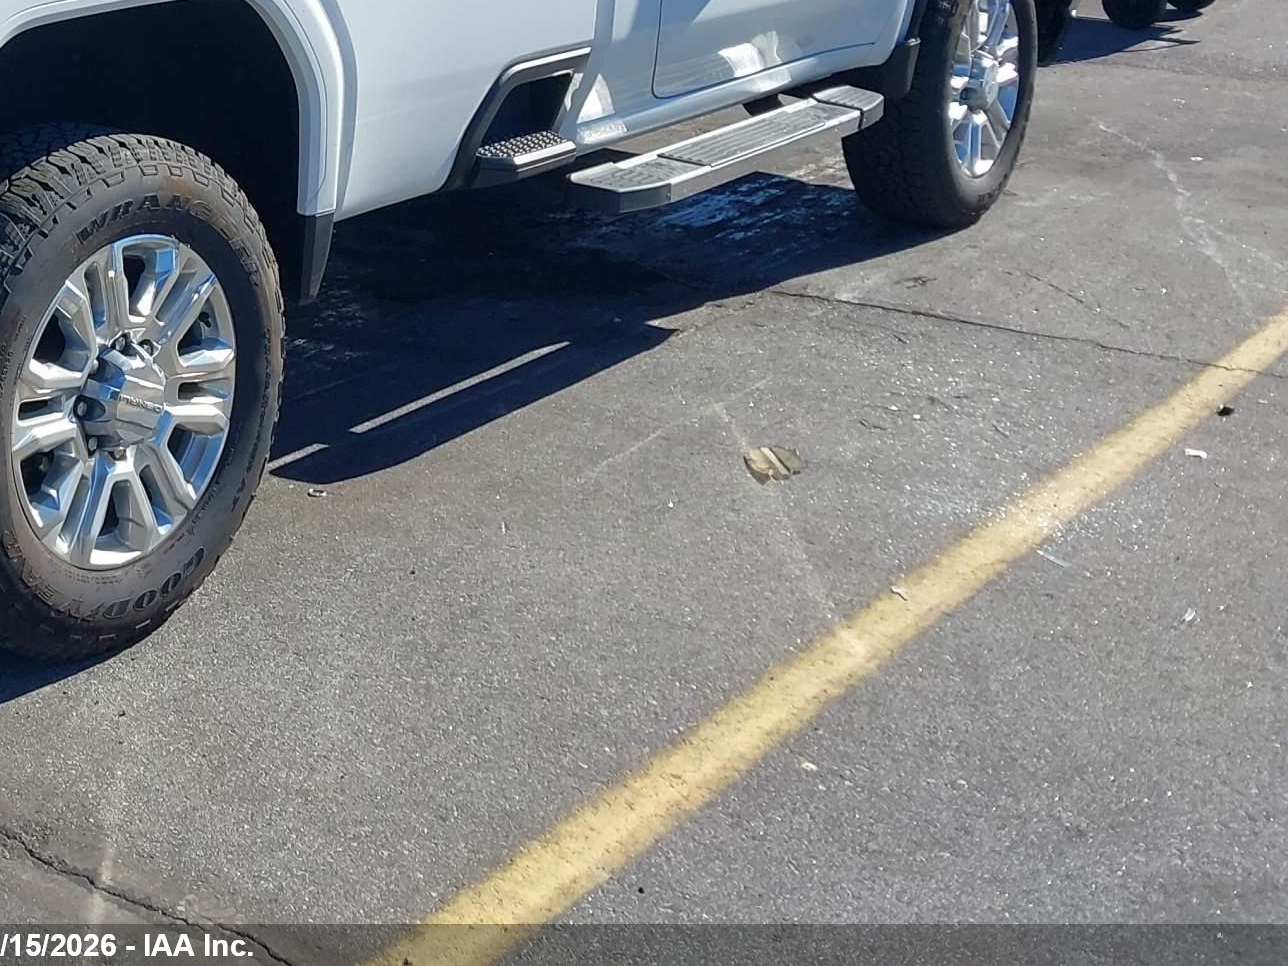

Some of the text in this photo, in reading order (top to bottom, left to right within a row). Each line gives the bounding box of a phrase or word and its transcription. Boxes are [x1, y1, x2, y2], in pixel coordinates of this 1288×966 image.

[75, 193, 261, 287] WRANGLER
[119, 393, 162, 414] DENALI
[1, 530, 206, 622] GOODYEAR
